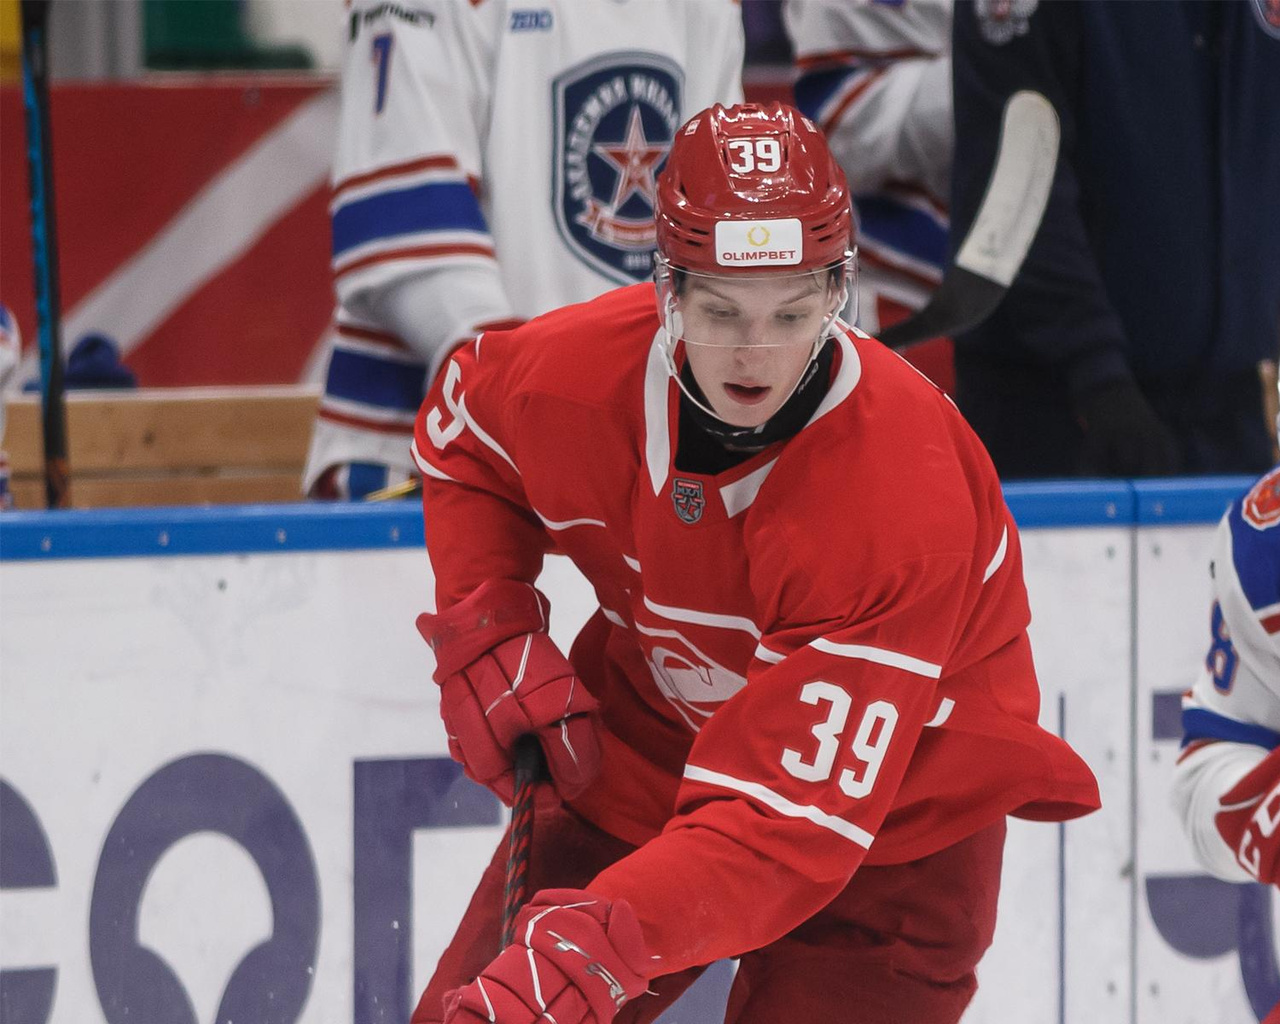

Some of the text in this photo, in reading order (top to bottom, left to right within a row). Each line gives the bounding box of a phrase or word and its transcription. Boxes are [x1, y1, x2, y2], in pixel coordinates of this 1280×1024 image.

[728, 139, 783, 174] 39
[722, 250, 797, 261] OLIMPBET
[780, 680, 900, 800] 39
